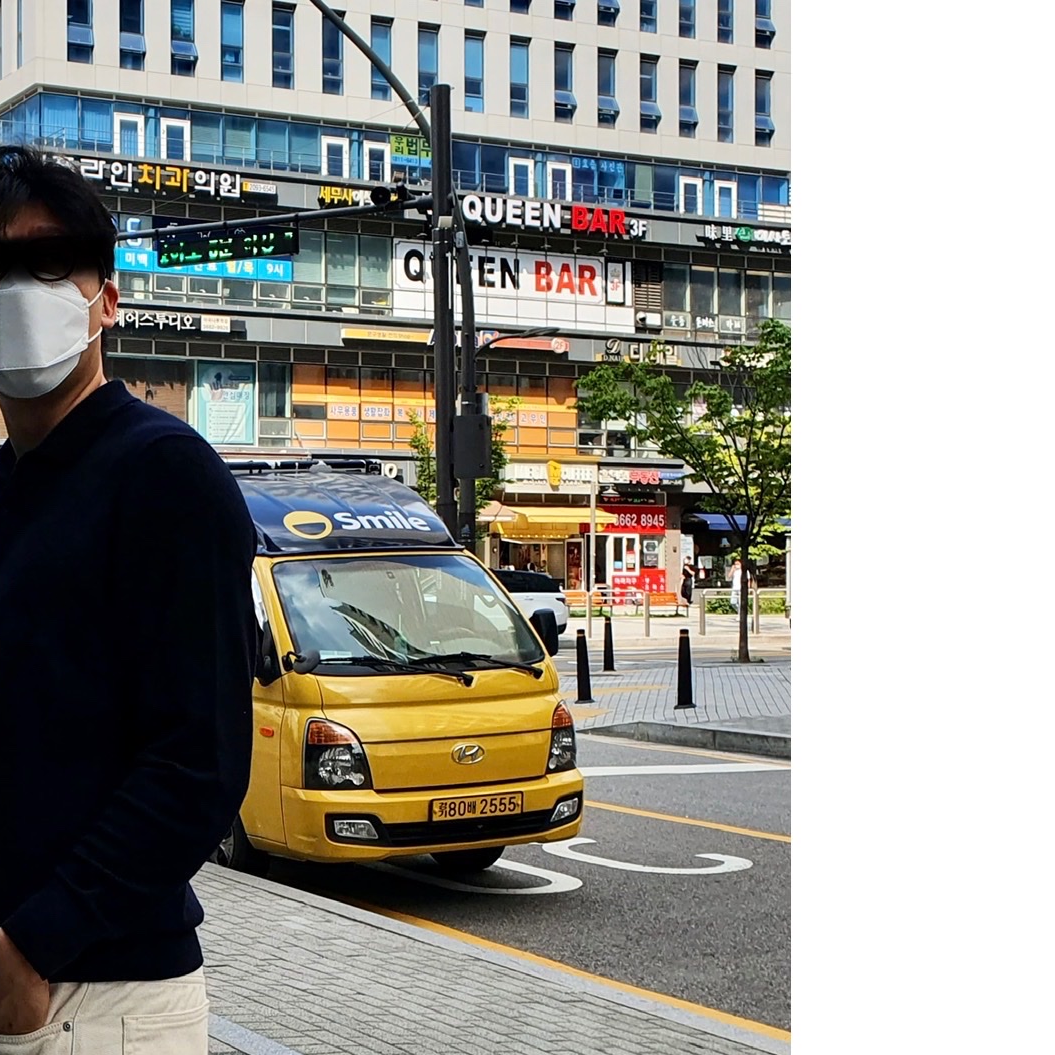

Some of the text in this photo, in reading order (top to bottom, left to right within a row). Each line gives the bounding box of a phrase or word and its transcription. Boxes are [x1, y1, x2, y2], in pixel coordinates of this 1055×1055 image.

[462, 194, 647, 236] QUEEN BAR 3F
[404, 249, 598, 297] QEN BAR
[333, 510, 432, 532] Smile
[640, 514, 665, 527] 8945
[479, 796, 517, 815] 2555
